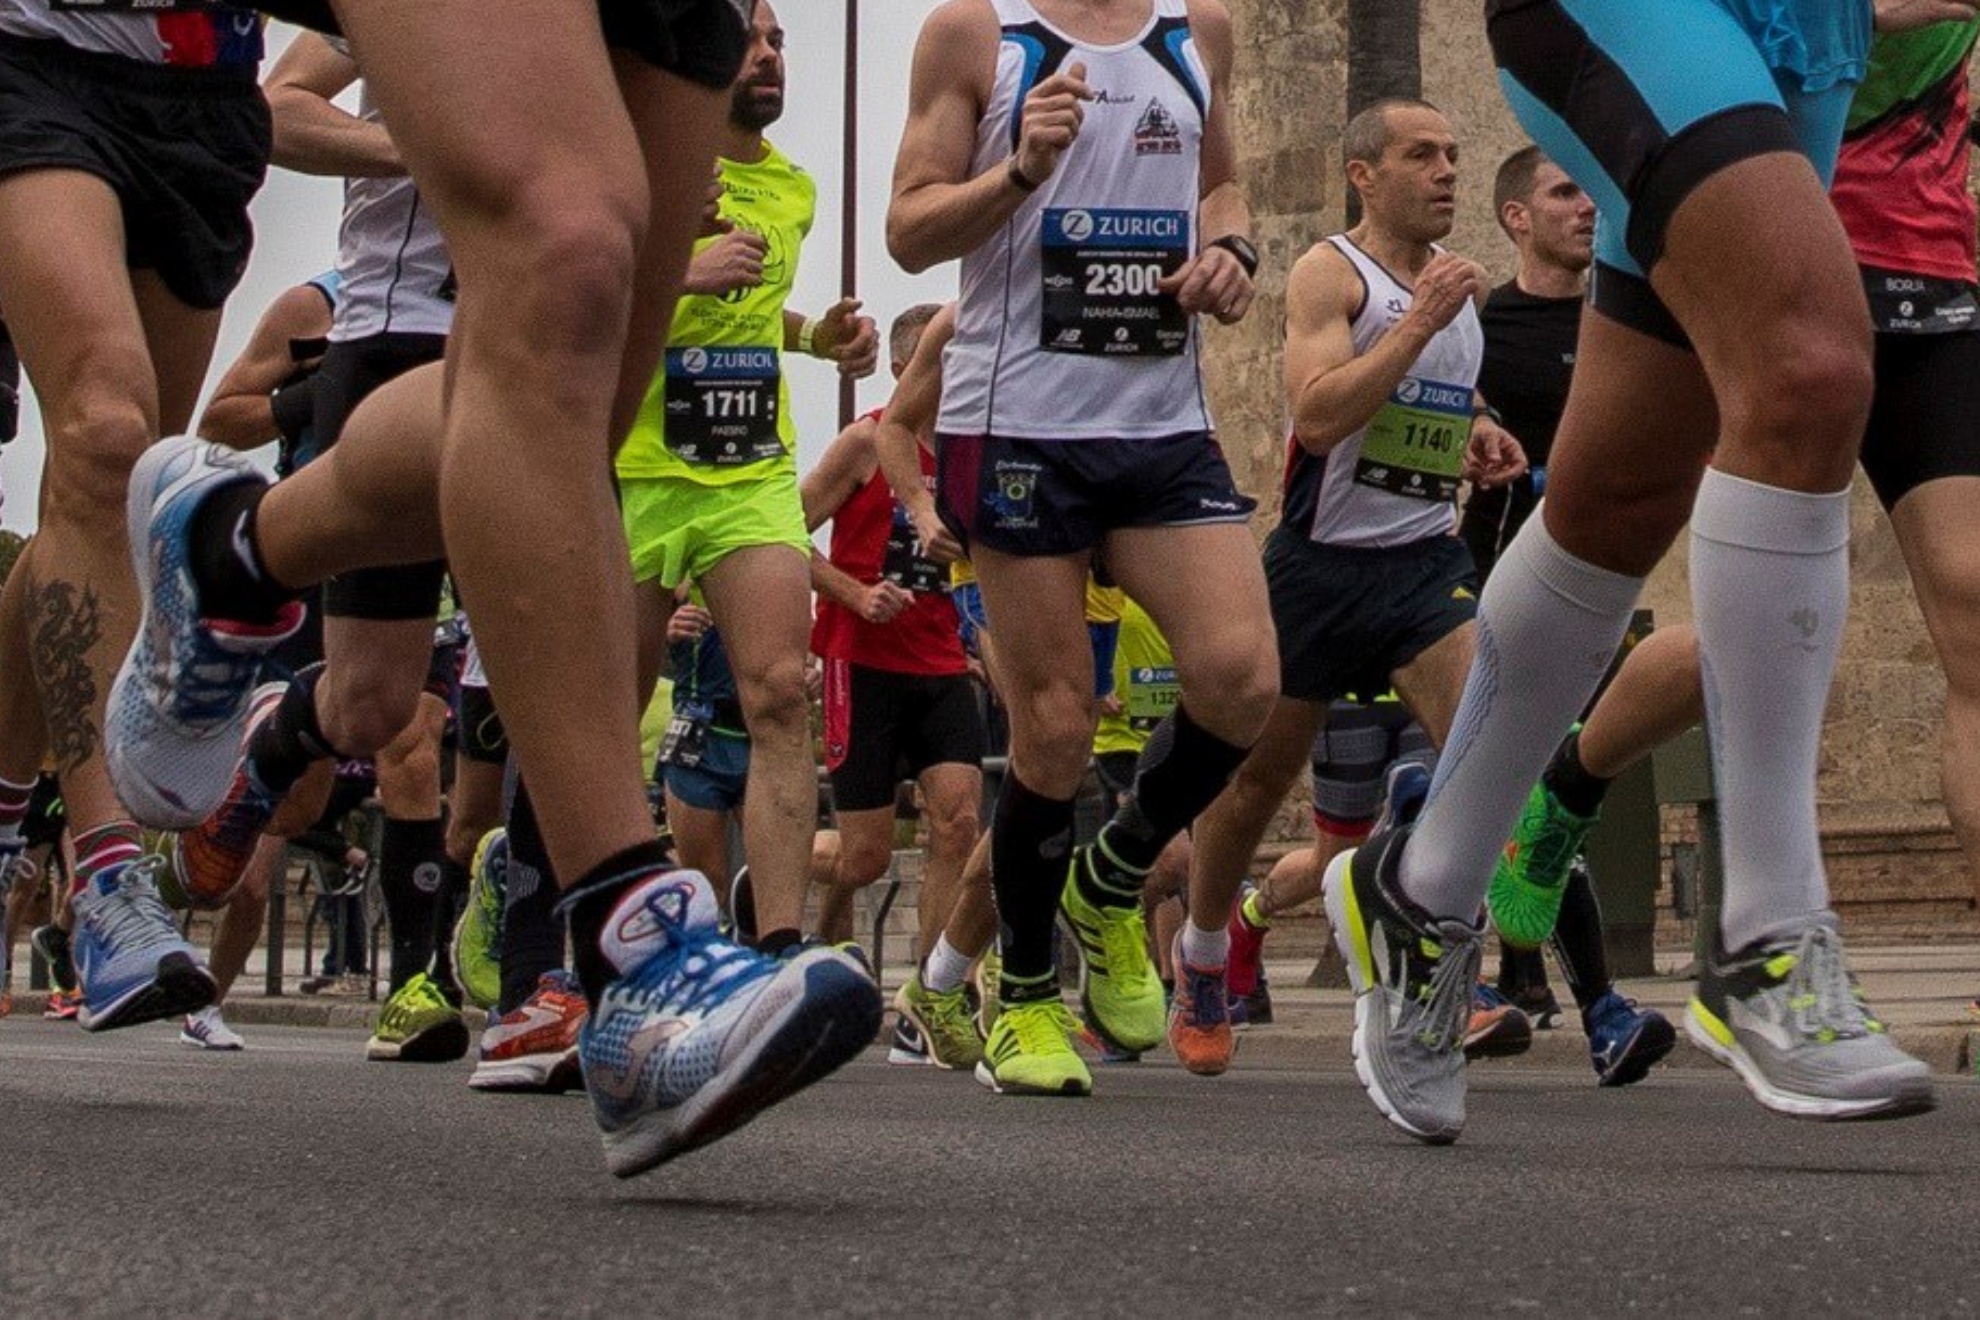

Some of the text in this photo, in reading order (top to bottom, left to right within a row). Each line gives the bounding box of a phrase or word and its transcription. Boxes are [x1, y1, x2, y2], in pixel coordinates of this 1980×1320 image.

[1099, 216, 1178, 236] ZURICH
[1085, 264, 1162, 296] 2300
[702, 390, 756, 417] 1711
[1422, 387, 1468, 408] ZURICH
[1404, 422, 1453, 453] 1140
